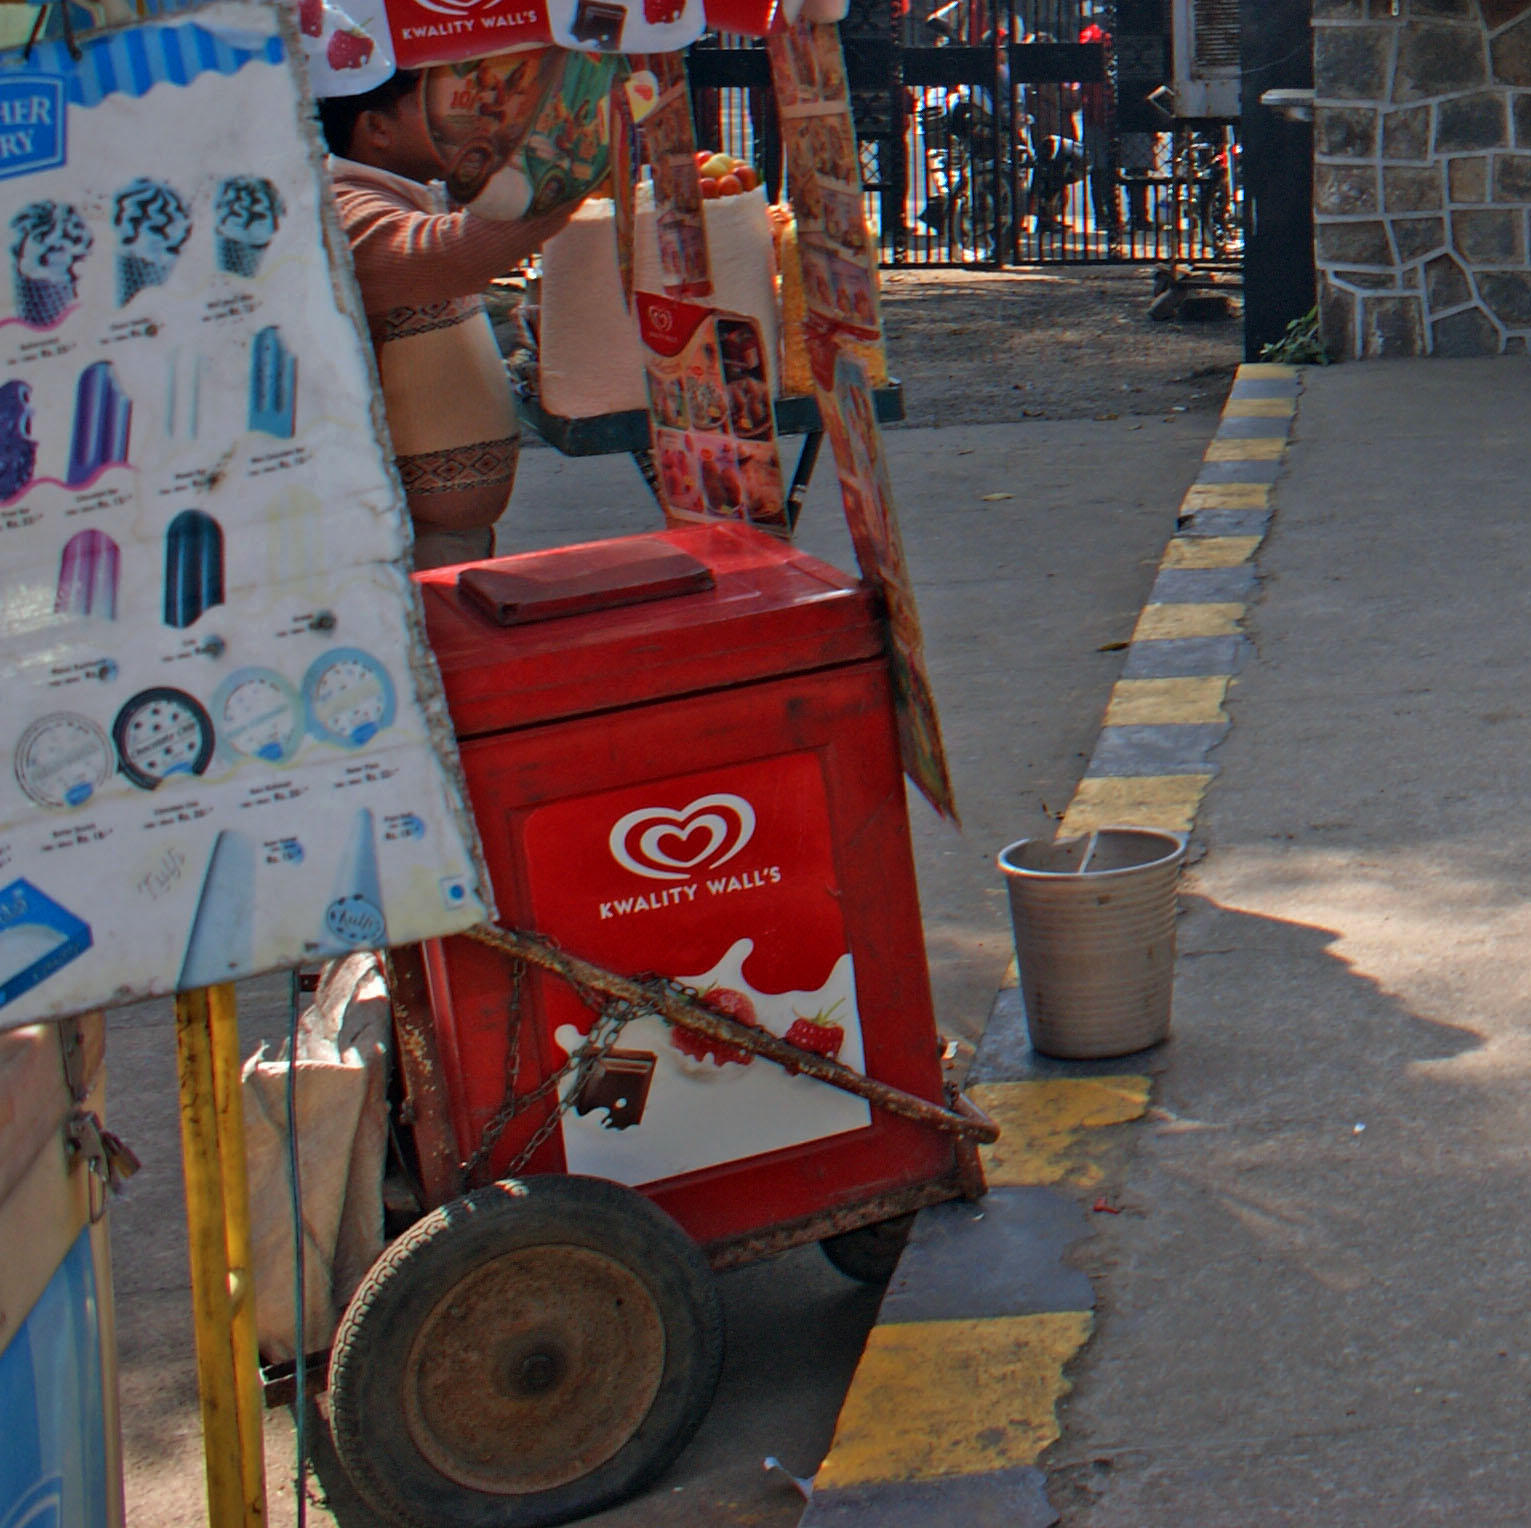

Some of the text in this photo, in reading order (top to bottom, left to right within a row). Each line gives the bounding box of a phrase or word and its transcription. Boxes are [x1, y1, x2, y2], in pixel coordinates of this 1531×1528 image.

[402, 10, 538, 41] KWALITY WALL'S
[600, 866, 782, 920] KWALITY WALL'S
